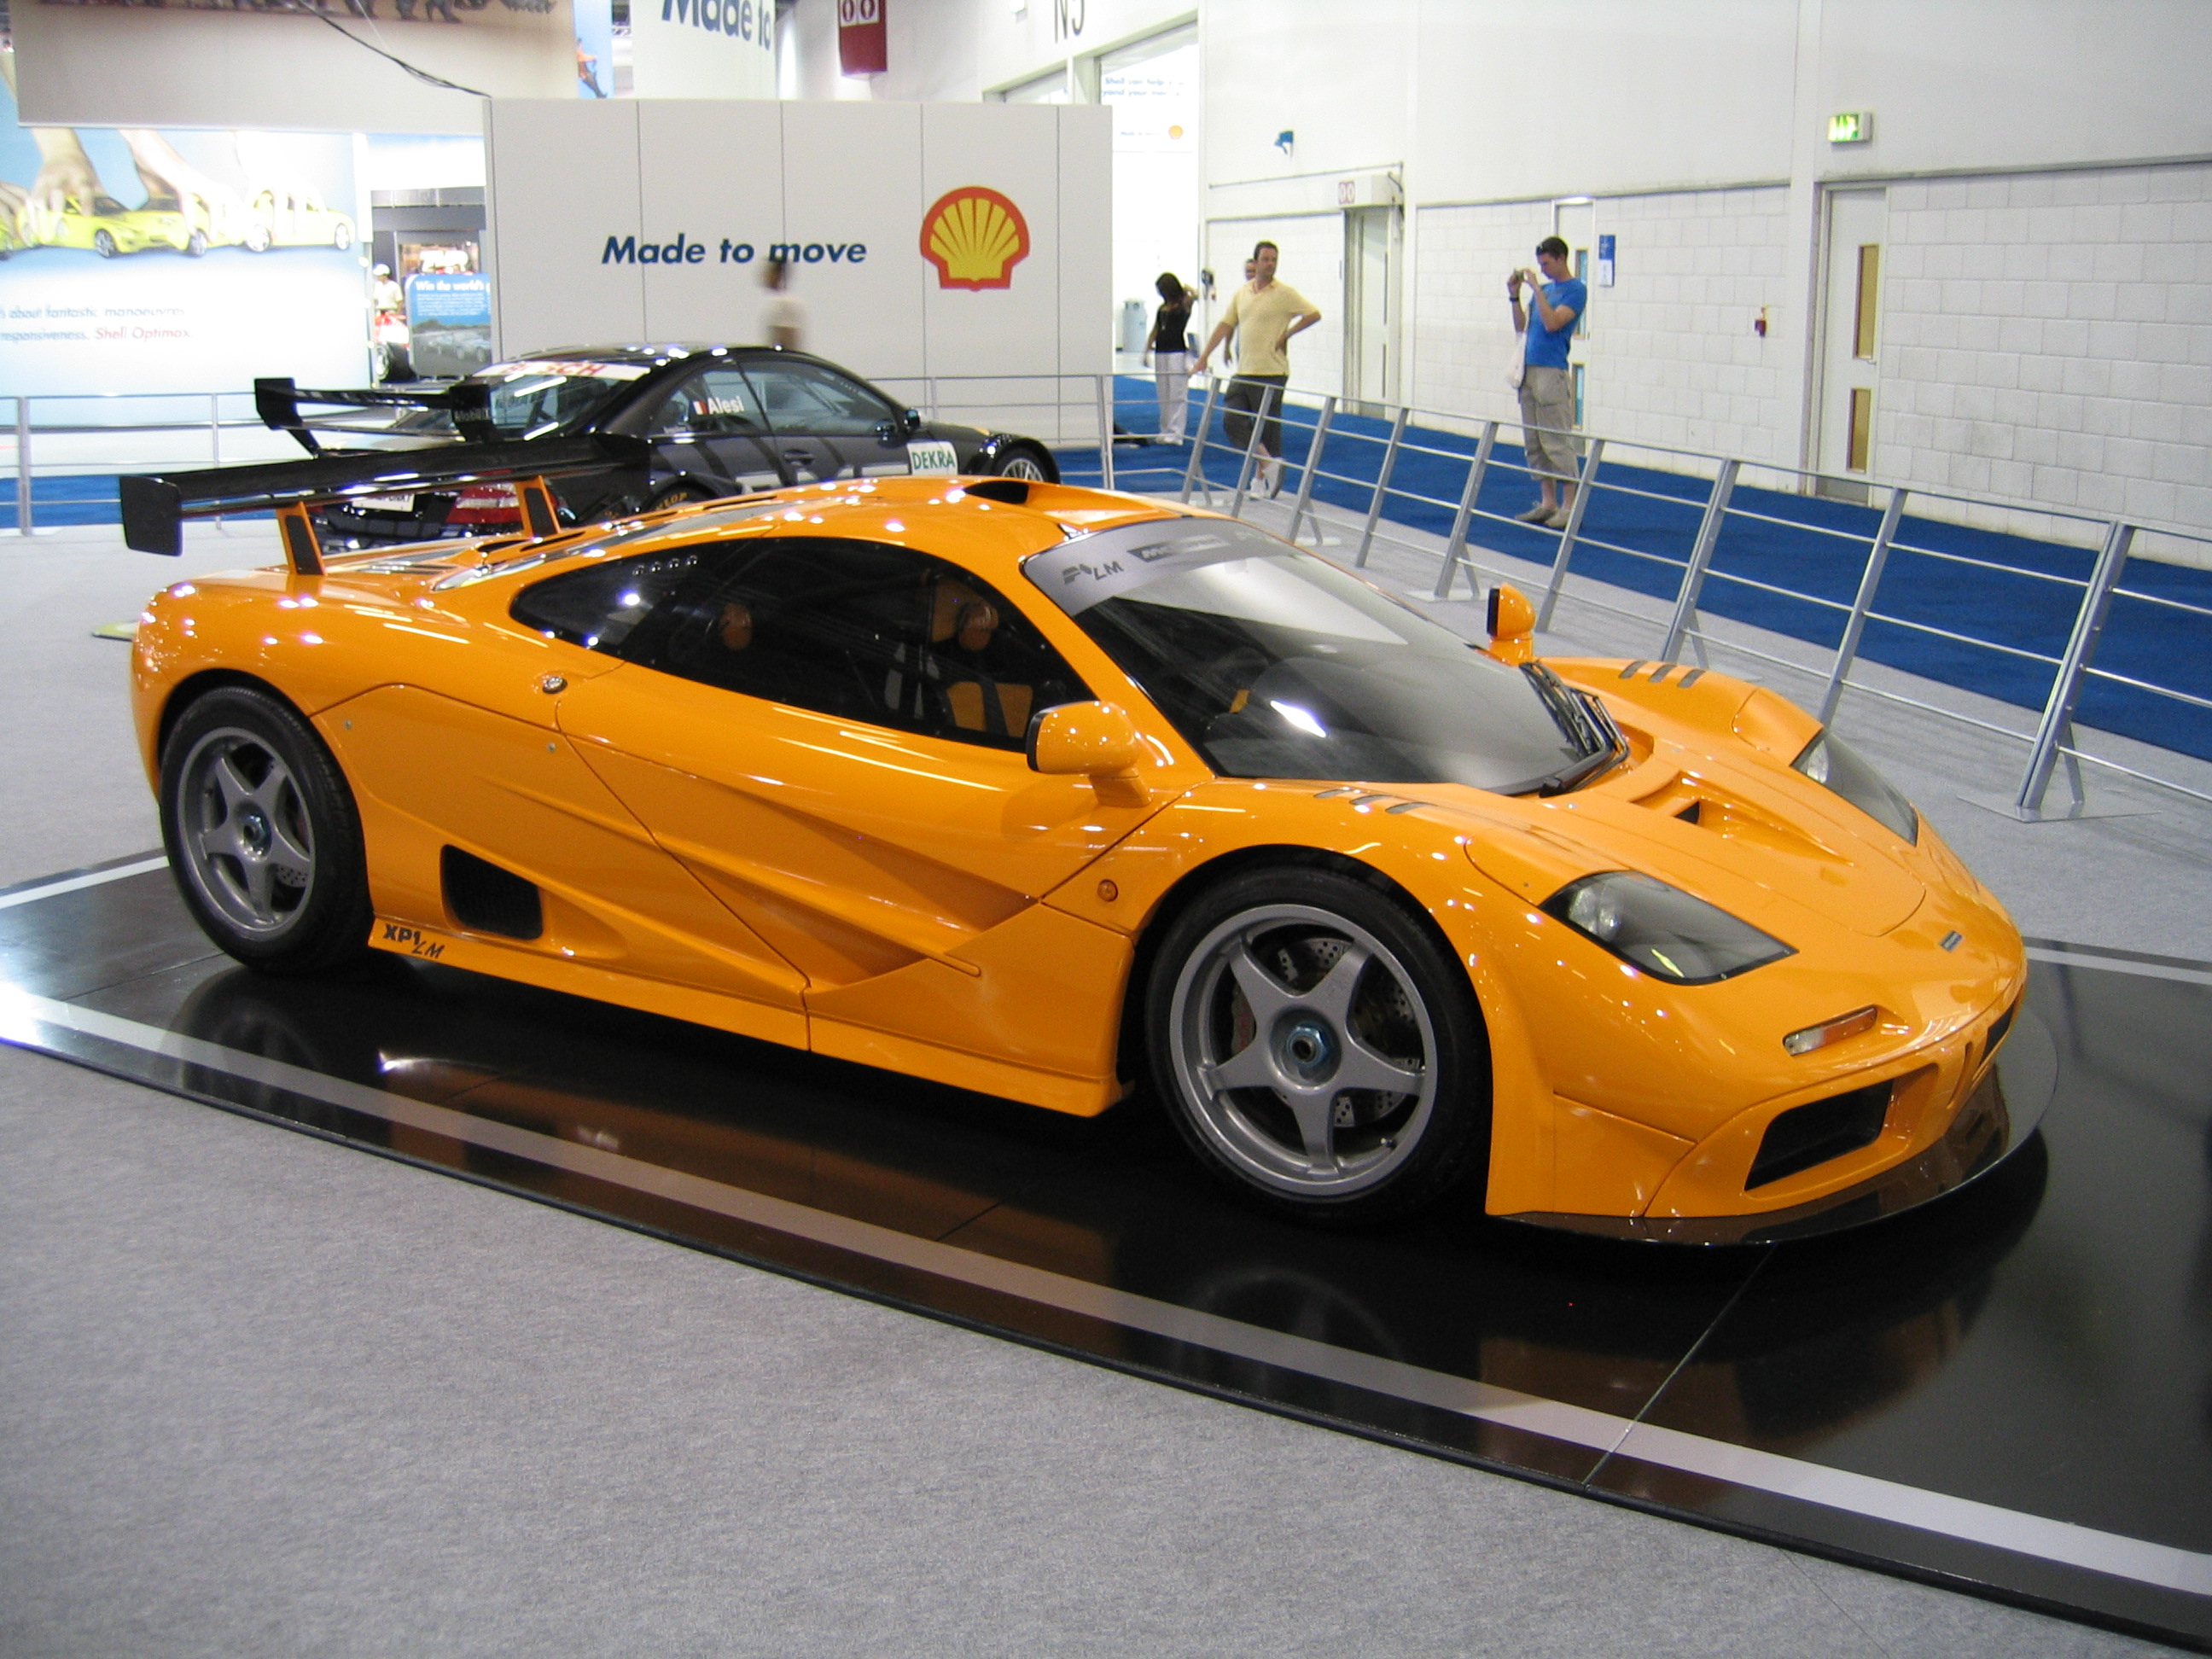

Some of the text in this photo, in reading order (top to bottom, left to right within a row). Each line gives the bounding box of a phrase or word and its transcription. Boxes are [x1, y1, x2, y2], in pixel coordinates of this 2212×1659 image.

[602, 233, 867, 264] Made to move
[95, 327, 127, 340] Shell
[707, 396, 745, 415] Alesi
[911, 449, 956, 470] DEKRA
